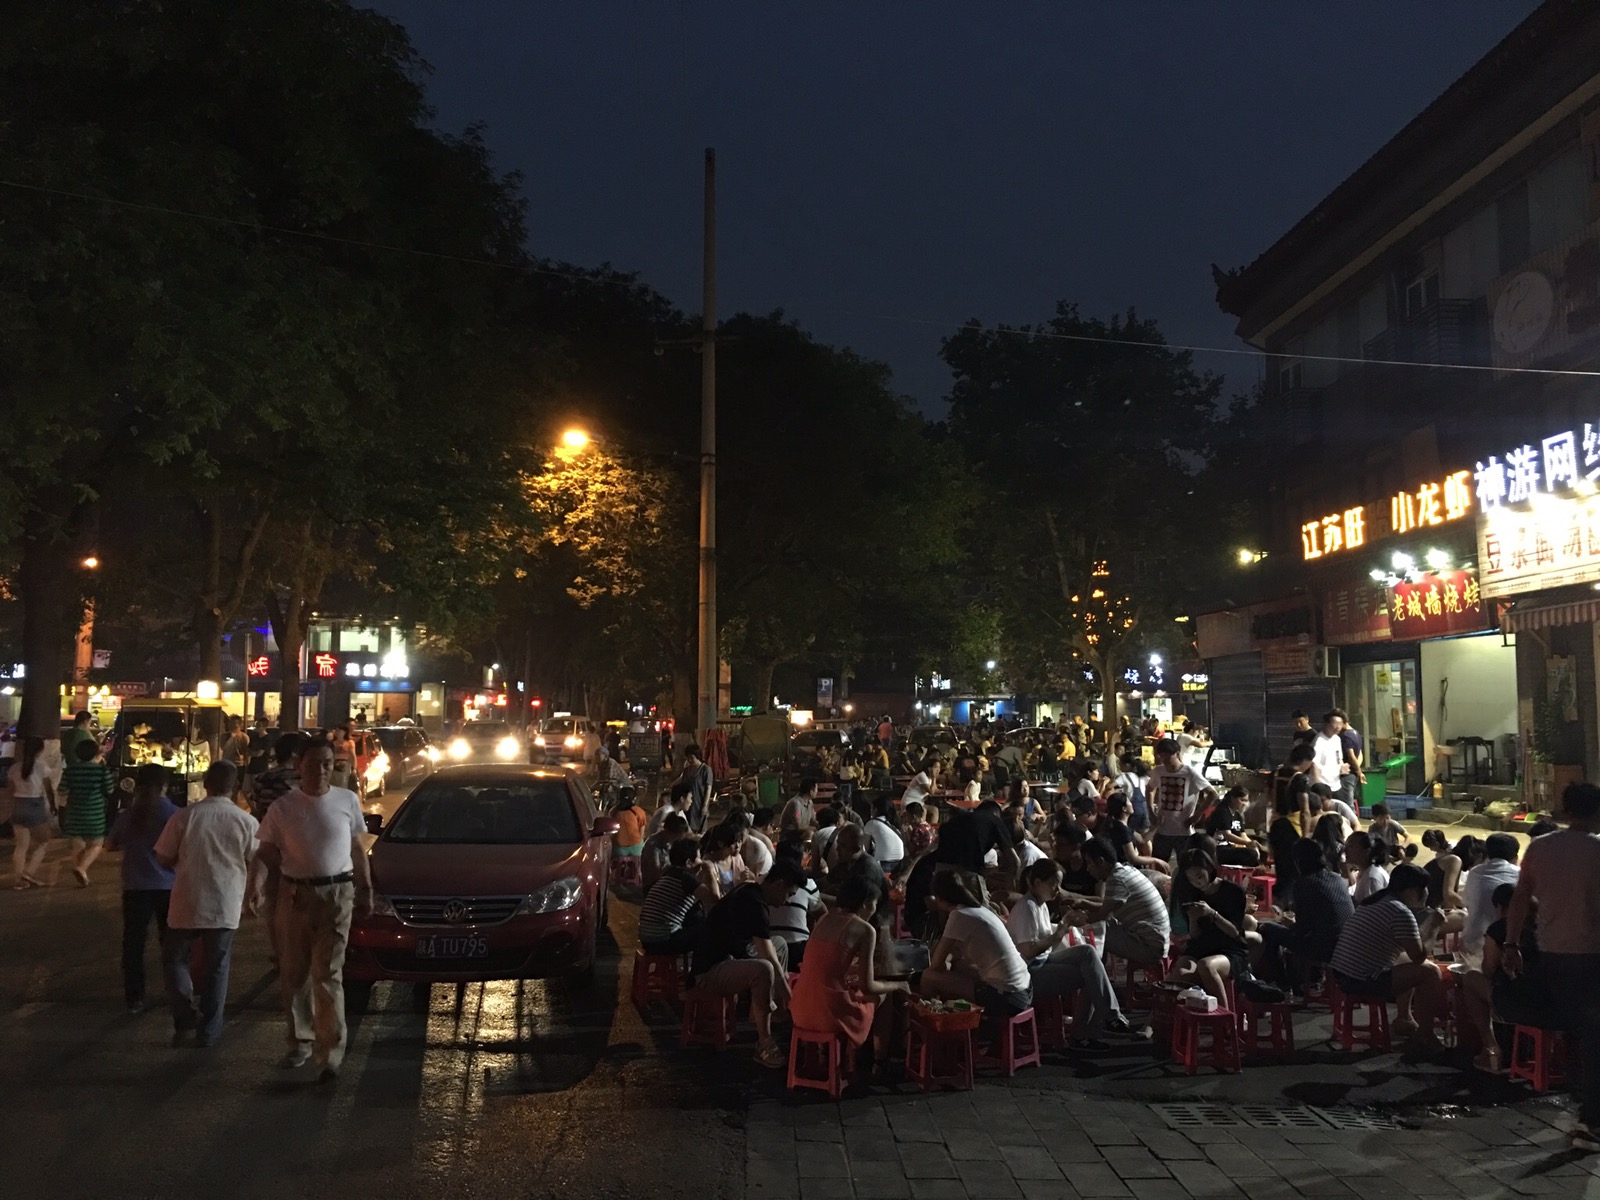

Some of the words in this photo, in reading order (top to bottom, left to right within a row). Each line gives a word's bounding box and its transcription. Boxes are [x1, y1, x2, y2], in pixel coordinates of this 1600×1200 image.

[1392, 577, 1480, 622] 老城墙烧烤
[820, 679, 830, 691] P
